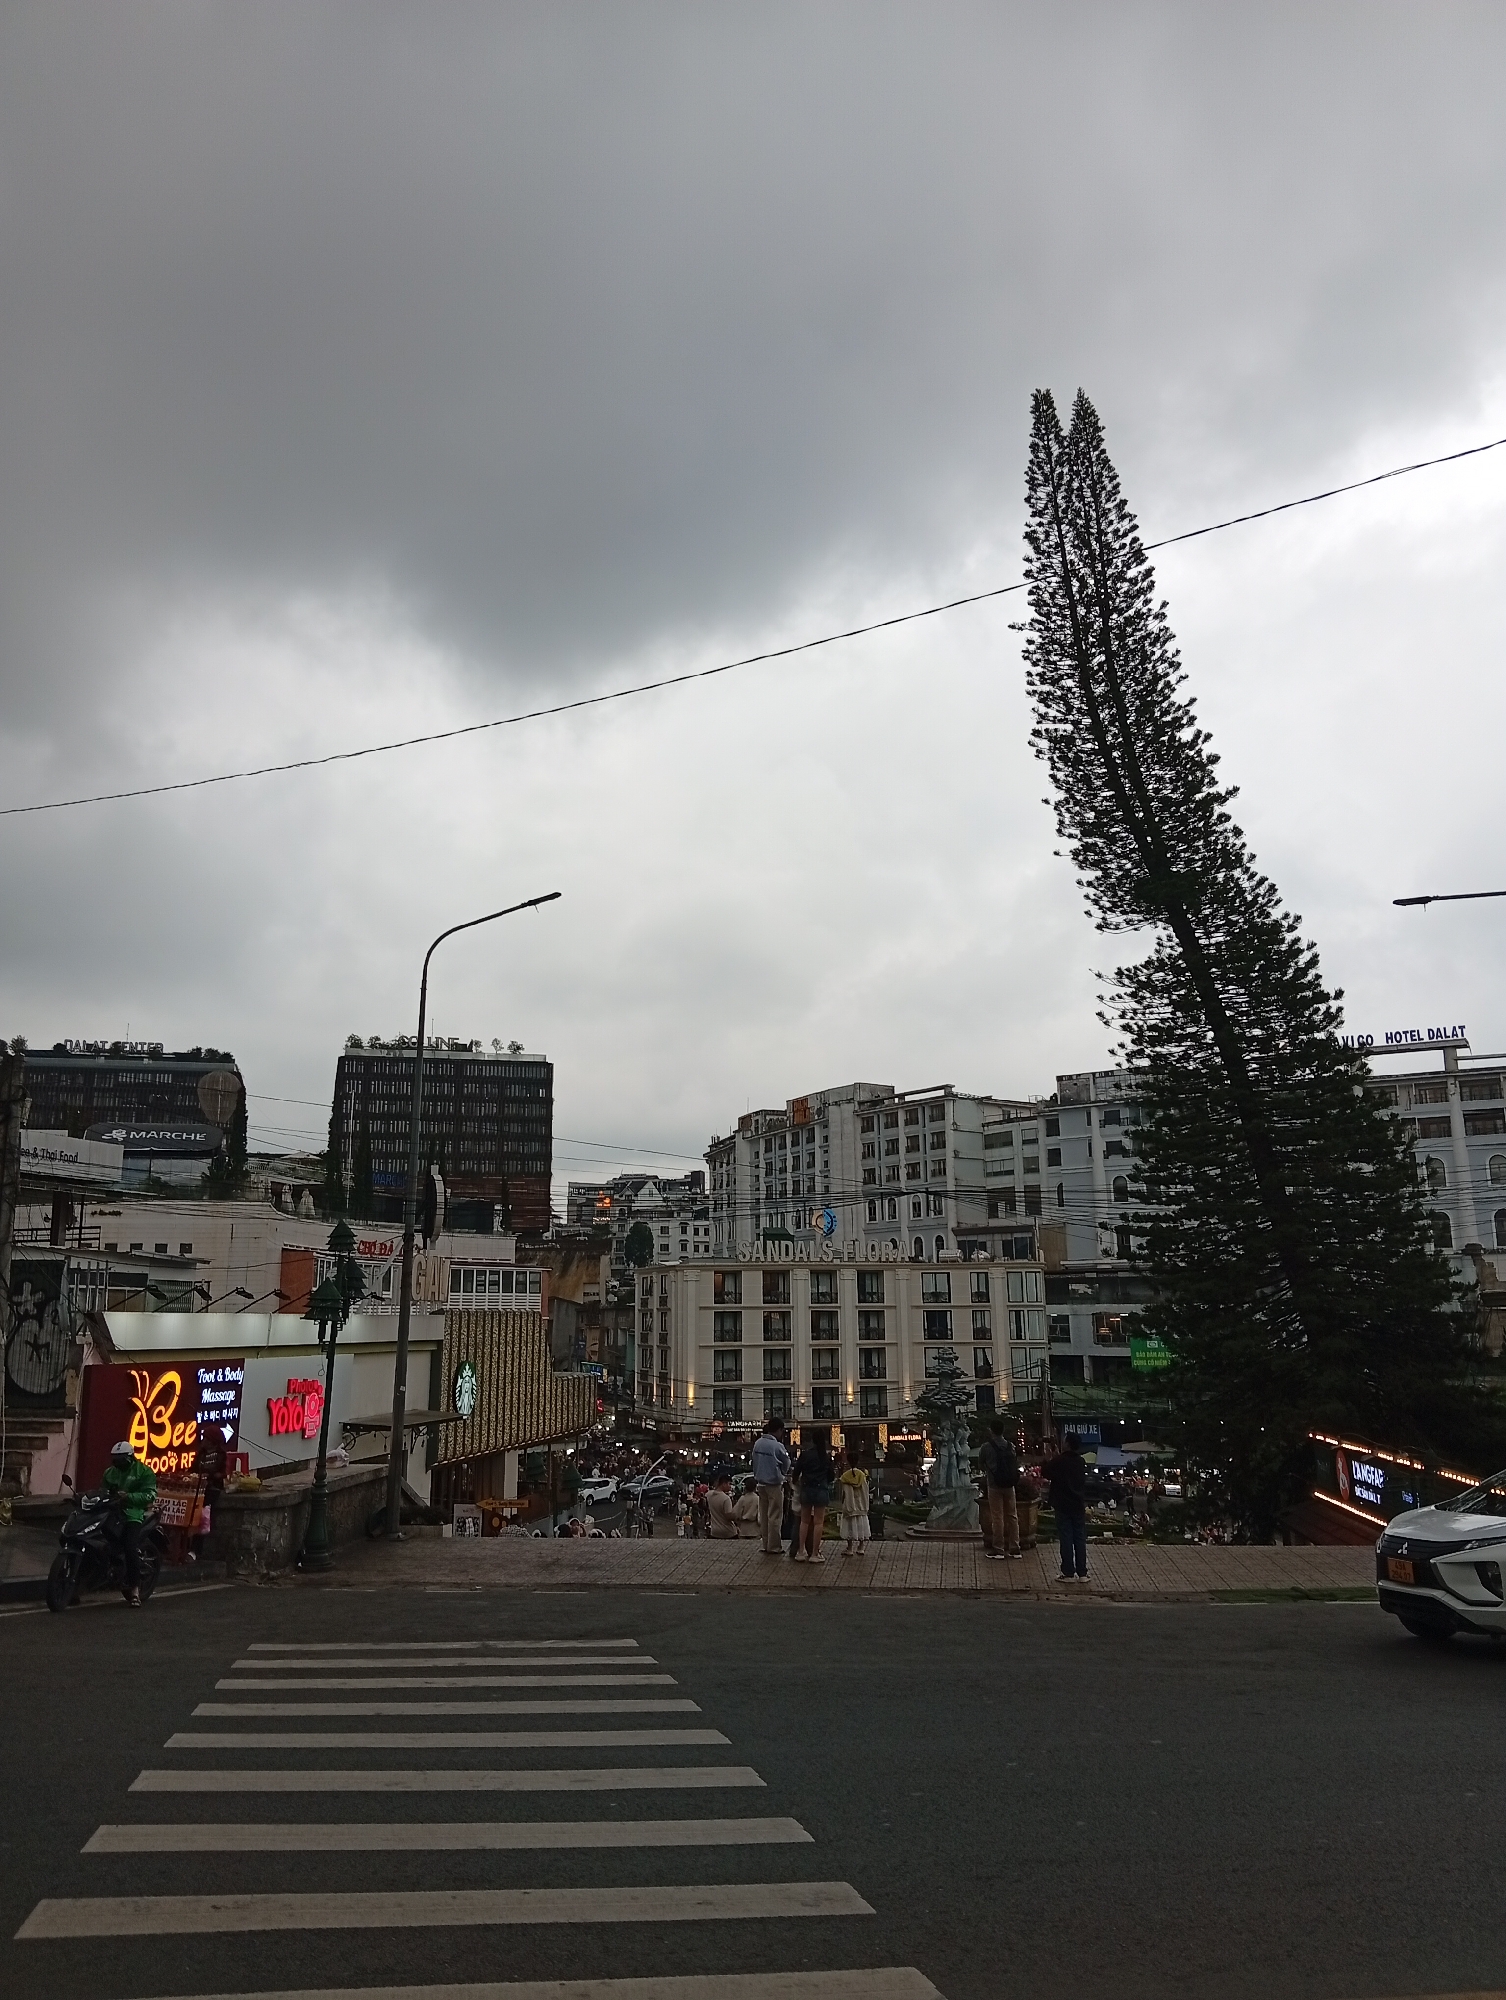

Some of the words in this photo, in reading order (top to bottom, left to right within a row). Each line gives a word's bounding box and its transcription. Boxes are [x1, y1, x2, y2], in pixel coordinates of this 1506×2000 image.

[1385, 1029, 1425, 1044] HOTEL
[1427, 1025, 1466, 1040] DALAT
[113, 1040, 164, 1054] ENTER
[41, 1148, 58, 1161] Thai
[60, 1150, 79, 1164] Food
[738, 1240, 834, 1262] SANDALS
[843, 1240, 910, 1262] FLORA
[197, 1368, 216, 1384] Foot
[217, 1368, 224, 1382] &
[224, 1366, 244, 1385] Body
[201, 1387, 236, 1406] Massage
[1089, 1424, 1098, 1435] XE
